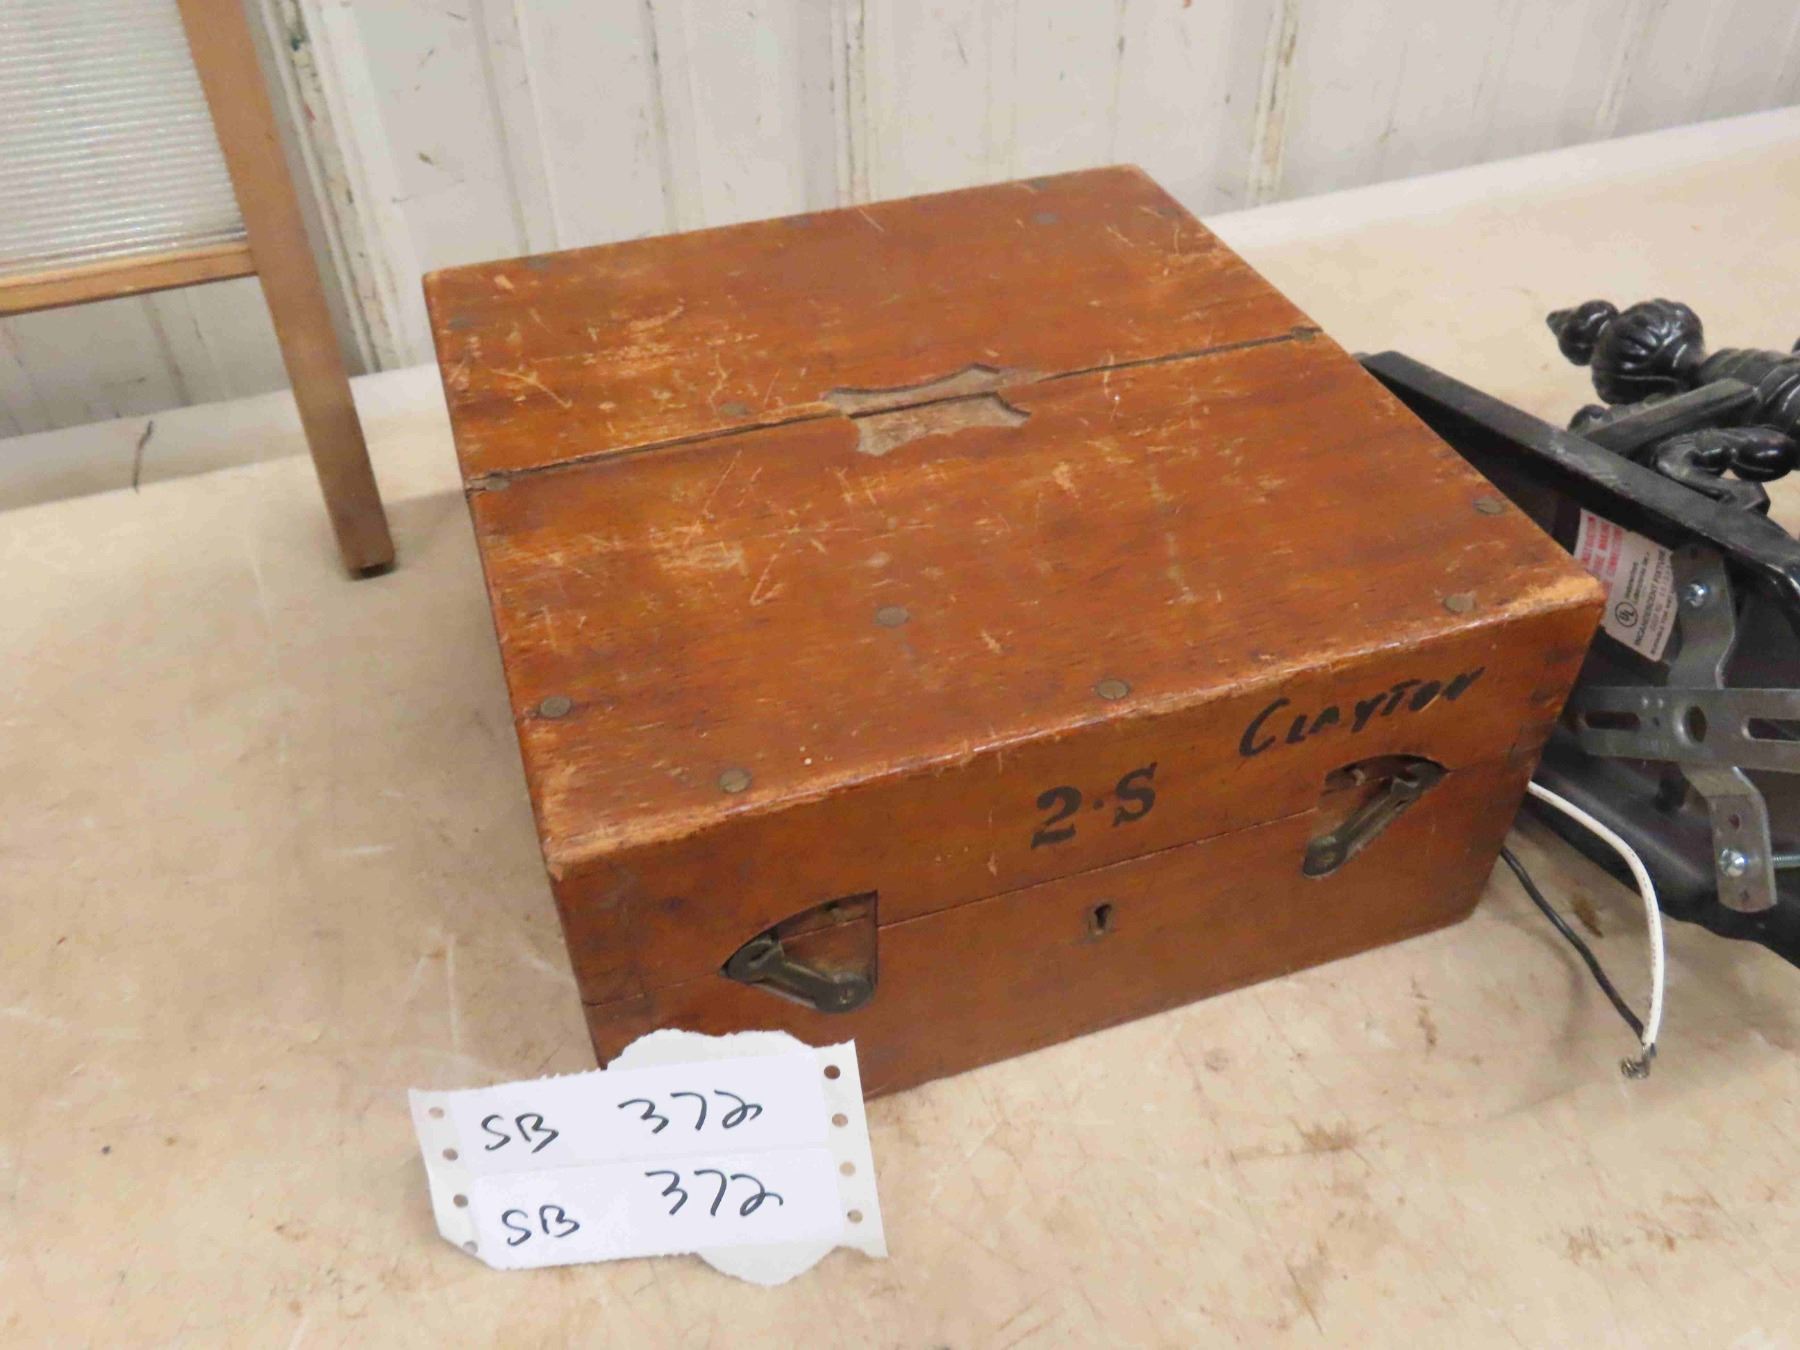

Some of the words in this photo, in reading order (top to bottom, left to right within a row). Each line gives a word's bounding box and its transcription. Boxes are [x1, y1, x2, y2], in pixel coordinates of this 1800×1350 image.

[481, 1113, 559, 1153] SB
[617, 1089, 763, 1134] 372
[501, 1204, 580, 1247] SB
[644, 1168, 784, 1216] 372
